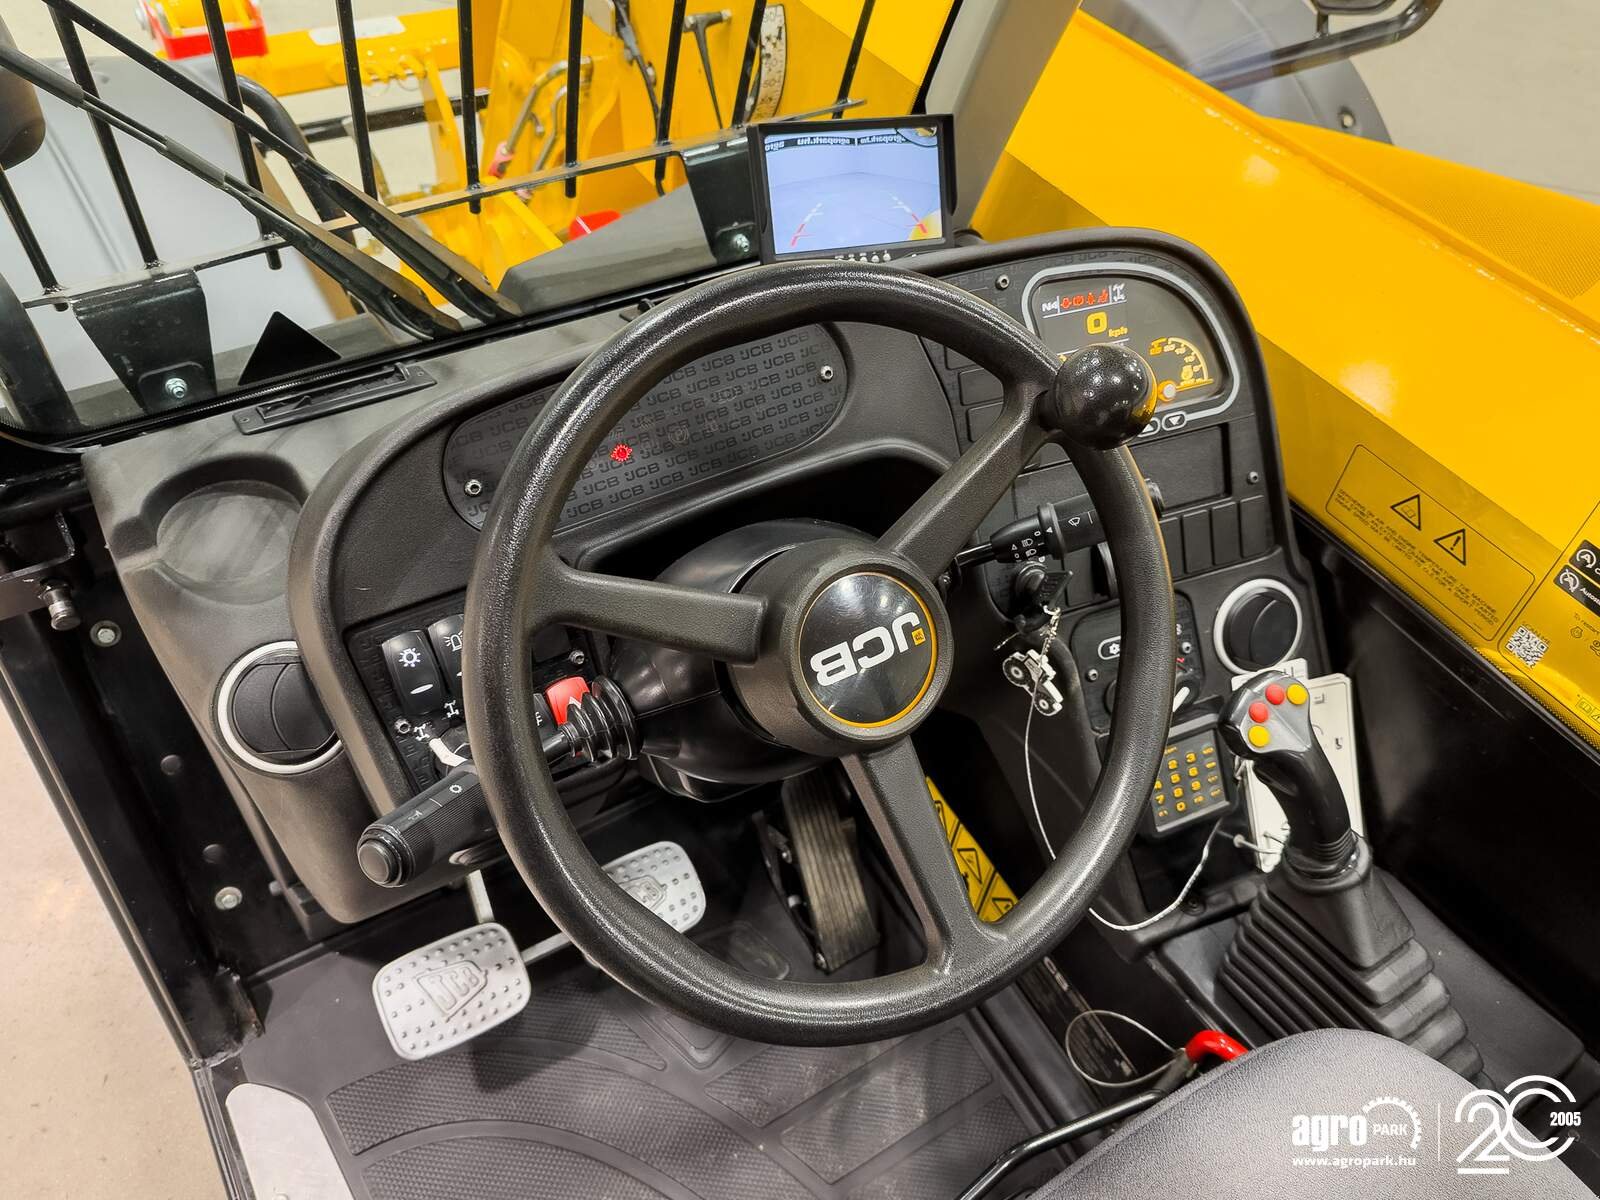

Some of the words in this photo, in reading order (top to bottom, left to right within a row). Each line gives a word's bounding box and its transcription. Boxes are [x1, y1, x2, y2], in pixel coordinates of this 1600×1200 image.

[702, 354, 736, 372] JCB
[740, 342, 774, 360] JCB
[777, 331, 810, 348] JCB
[1109, 326, 1128, 337] kph
[647, 388, 682, 406] JCB
[686, 376, 721, 394] JCB
[725, 364, 759, 382] JCB
[763, 352, 796, 369] JCB
[710, 385, 744, 403] JCB
[748, 372, 782, 391] JCB
[785, 361, 818, 379] JCB
[640, 441, 675, 460] JCB
[719, 415, 752, 433] JCB
[756, 403, 789, 421] JCB
[792, 390, 826, 409] JCB
[656, 418, 691, 438] JCB
[698, 406, 730, 424] JCB
[734, 394, 767, 412] JCB
[770, 382, 803, 400] JCB
[566, 499, 604, 519] JCB
[608, 484, 645, 504] JCB
[650, 471, 685, 490] JCB
[688, 458, 723, 476] JCB
[764, 432, 797, 451] JCB
[582, 477, 620, 496] JCB
[624, 462, 660, 482] JCB
[664, 450, 699, 468] JCB
[704, 437, 738, 455] JCB
[742, 424, 775, 442] JCB
[779, 411, 811, 430] JCB
[810, 611, 921, 687] JCB
[428, 963, 480, 1010] JCB
